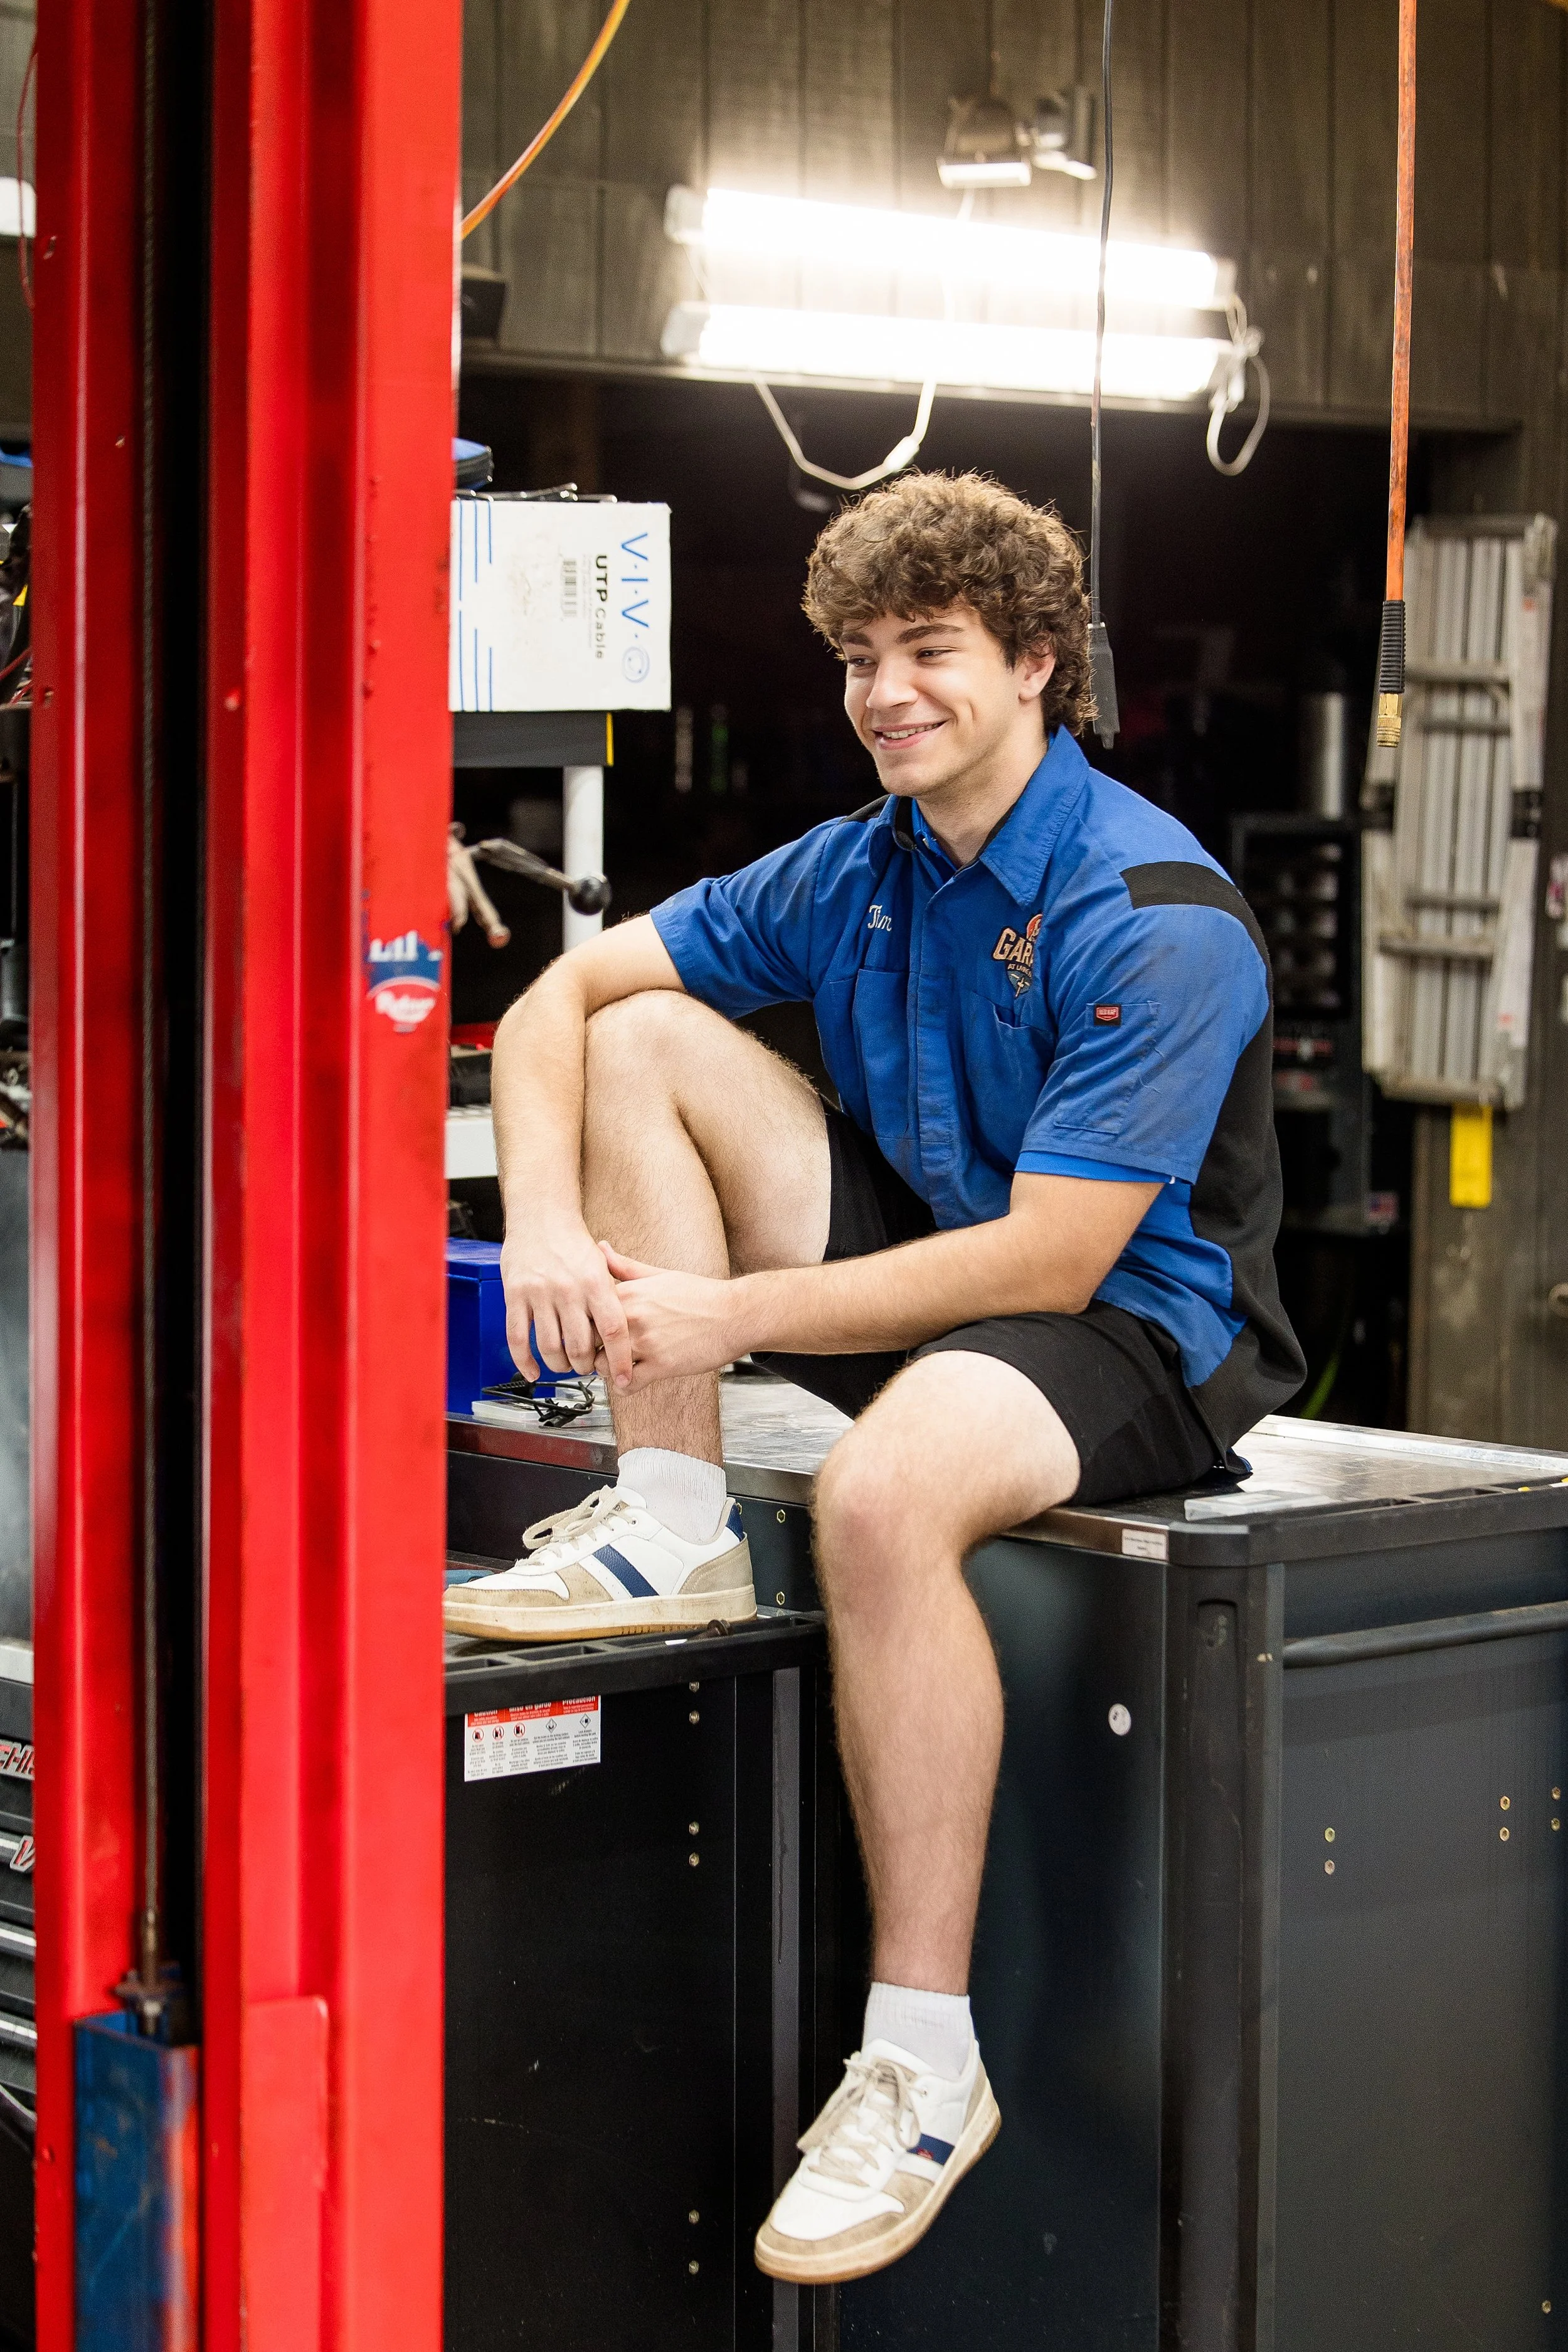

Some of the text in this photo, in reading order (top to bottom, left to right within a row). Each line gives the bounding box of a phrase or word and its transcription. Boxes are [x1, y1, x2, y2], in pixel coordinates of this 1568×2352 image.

[595, 555, 607, 659] UTP Cable
[867, 904, 892, 931] Tim
[993, 928, 1033, 967] GAR
